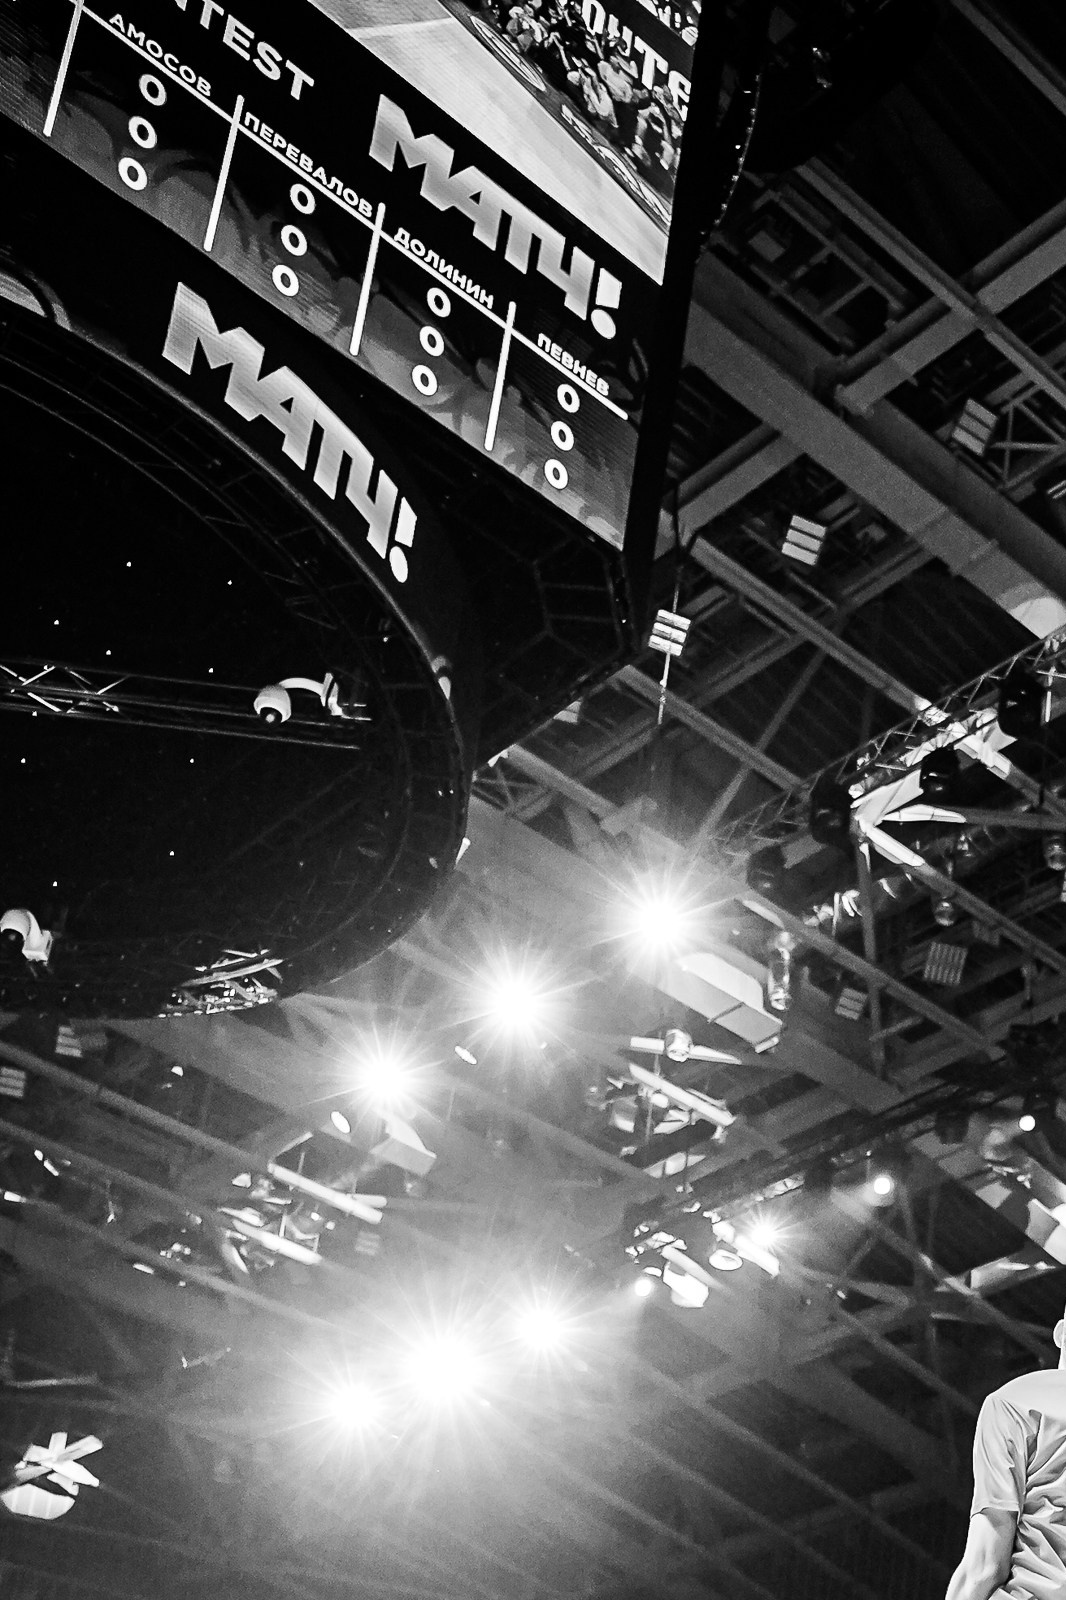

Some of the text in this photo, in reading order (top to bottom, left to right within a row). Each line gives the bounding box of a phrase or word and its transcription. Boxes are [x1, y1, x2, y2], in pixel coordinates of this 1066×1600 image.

[109, 14, 211, 96] АМОСОВ
[175, 0, 314, 100] TEST
[139, 75, 166, 105] 0
[129, 117, 157, 148] 0
[118, 157, 147, 190] 0
[245, 112, 372, 217] ПЕРЕВАЛОВ
[290, 184, 315, 214] 0
[369, 94, 622, 339] МАТЧ!
[281, 225, 307, 256] 0
[272, 265, 299, 296] 0
[394, 227, 493, 309] ДОЛИНИН
[427, 288, 450, 317] 0
[420, 326, 444, 356] 0
[538, 333, 609, 395] ПЕВНЕВ
[412, 365, 437, 395] 0
[557, 384, 579, 413] 0
[162, 282, 417, 583] МАТЧ!
[551, 421, 574, 450] 0
[545, 459, 568, 489] 0
